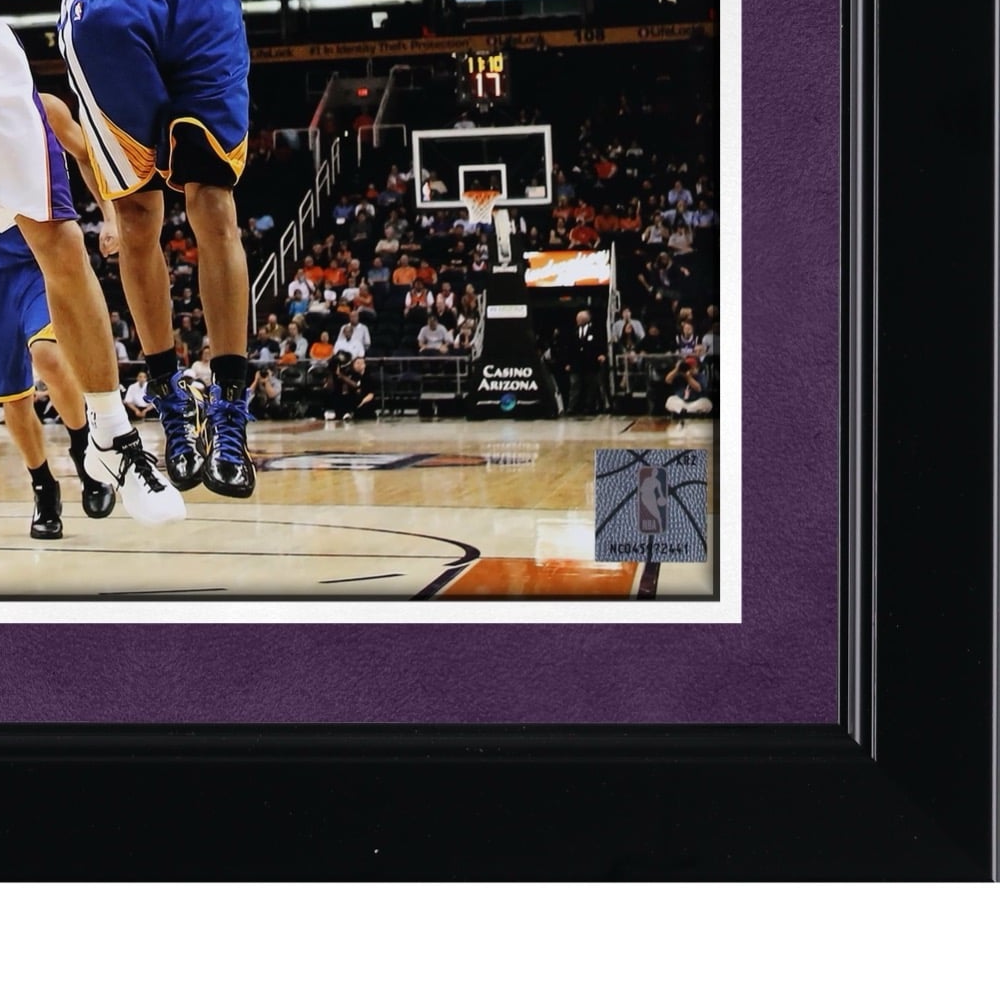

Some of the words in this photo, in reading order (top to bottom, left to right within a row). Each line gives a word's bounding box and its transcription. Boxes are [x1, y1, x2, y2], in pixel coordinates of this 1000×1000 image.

[475, 72, 501, 97] 17
[482, 364, 533, 379] CASINO
[478, 378, 538, 392] ARIZONA
